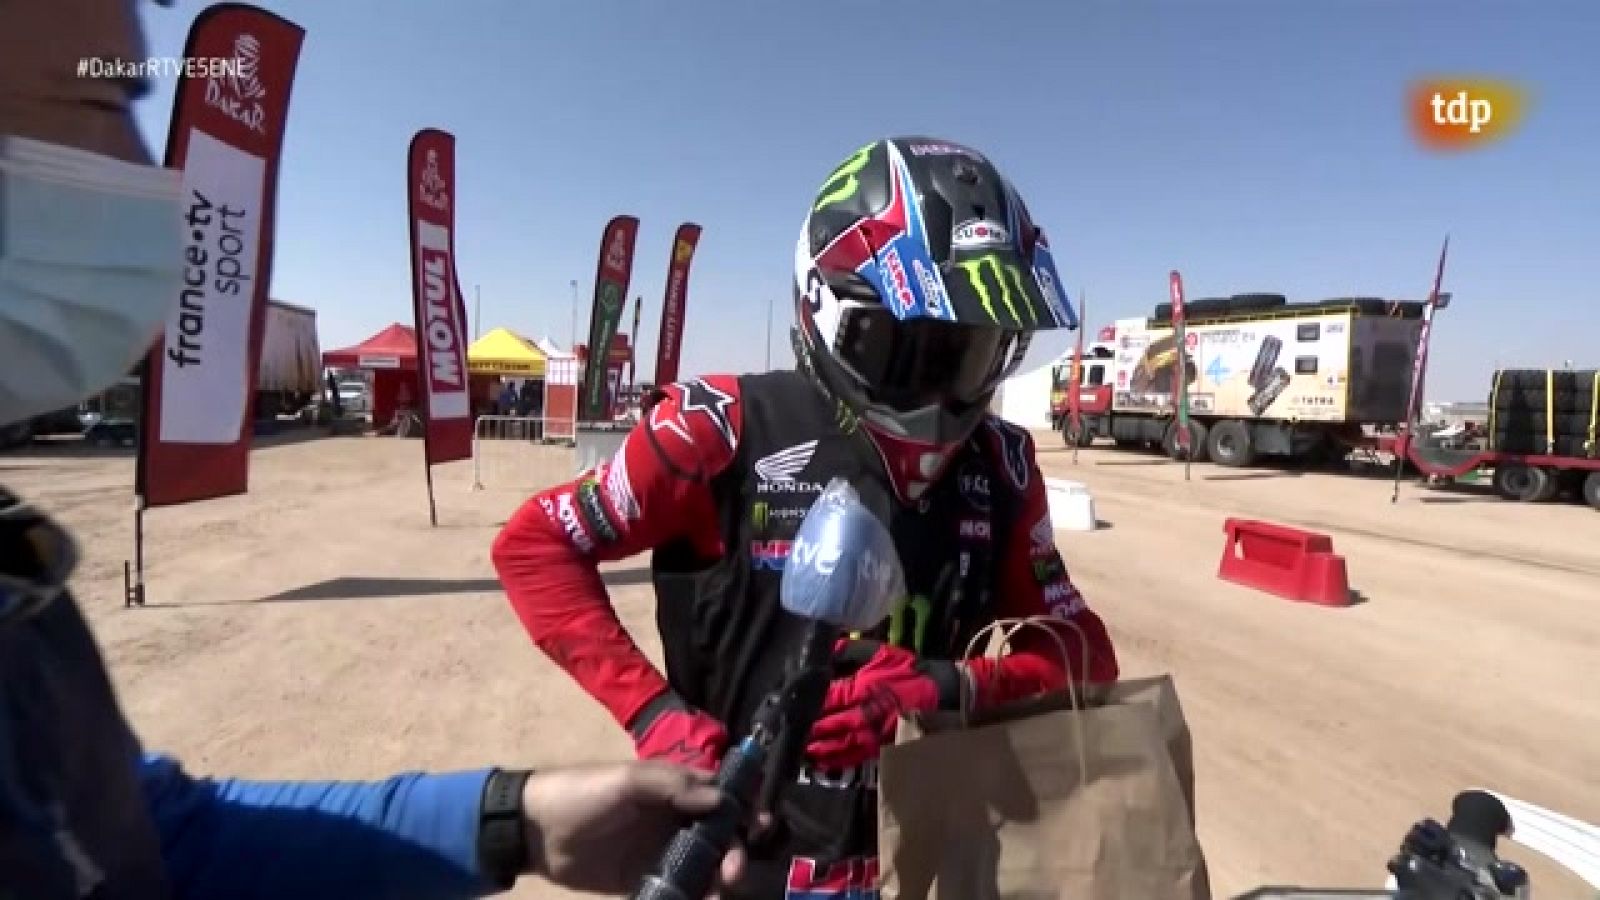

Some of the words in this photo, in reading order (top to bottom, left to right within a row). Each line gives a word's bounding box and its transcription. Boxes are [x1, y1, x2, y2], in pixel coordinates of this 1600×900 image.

[215, 203, 246, 296] sport
[422, 251, 461, 386] MOTUL
[757, 482, 826, 493] HONDA
